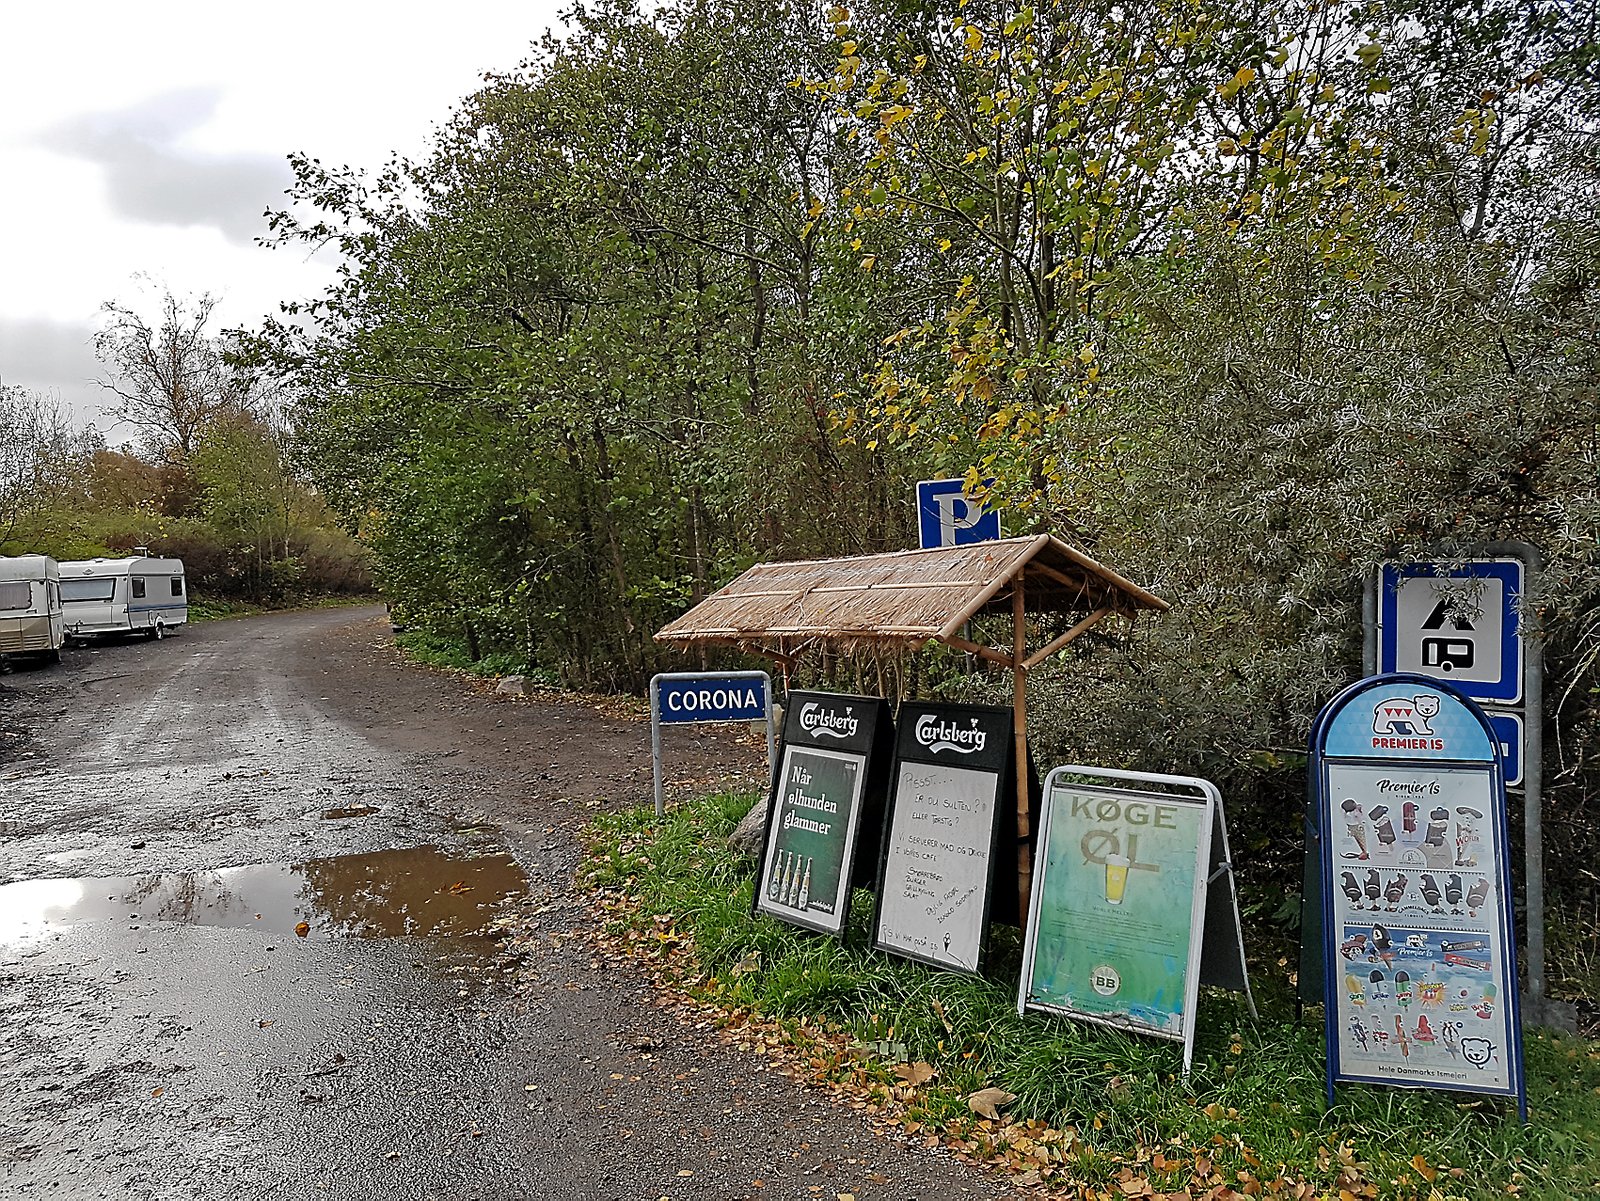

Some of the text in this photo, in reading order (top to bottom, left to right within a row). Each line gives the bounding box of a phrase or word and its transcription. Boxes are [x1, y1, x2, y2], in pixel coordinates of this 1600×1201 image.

[933, 492, 982, 546] P
[668, 689, 758, 711] CORONA
[800, 702, 859, 738] Carlsberg
[915, 714, 987, 753] Carlsberg
[1372, 737, 1444, 751] PREMIER IS
[791, 765, 812, 785] Når
[1376, 779, 1440, 795] Premier Is
[788, 787, 837, 814] ølhunden
[783, 809, 831, 835] glammer
[912, 811, 928, 821] ELLER
[1070, 796, 1178, 830] KØGE
[1080, 827, 1161, 874] ØL
[1096, 975, 1117, 989] BB
[1378, 1065, 1396, 1074] Hele
[1397, 1067, 1436, 1078] Danmarks
